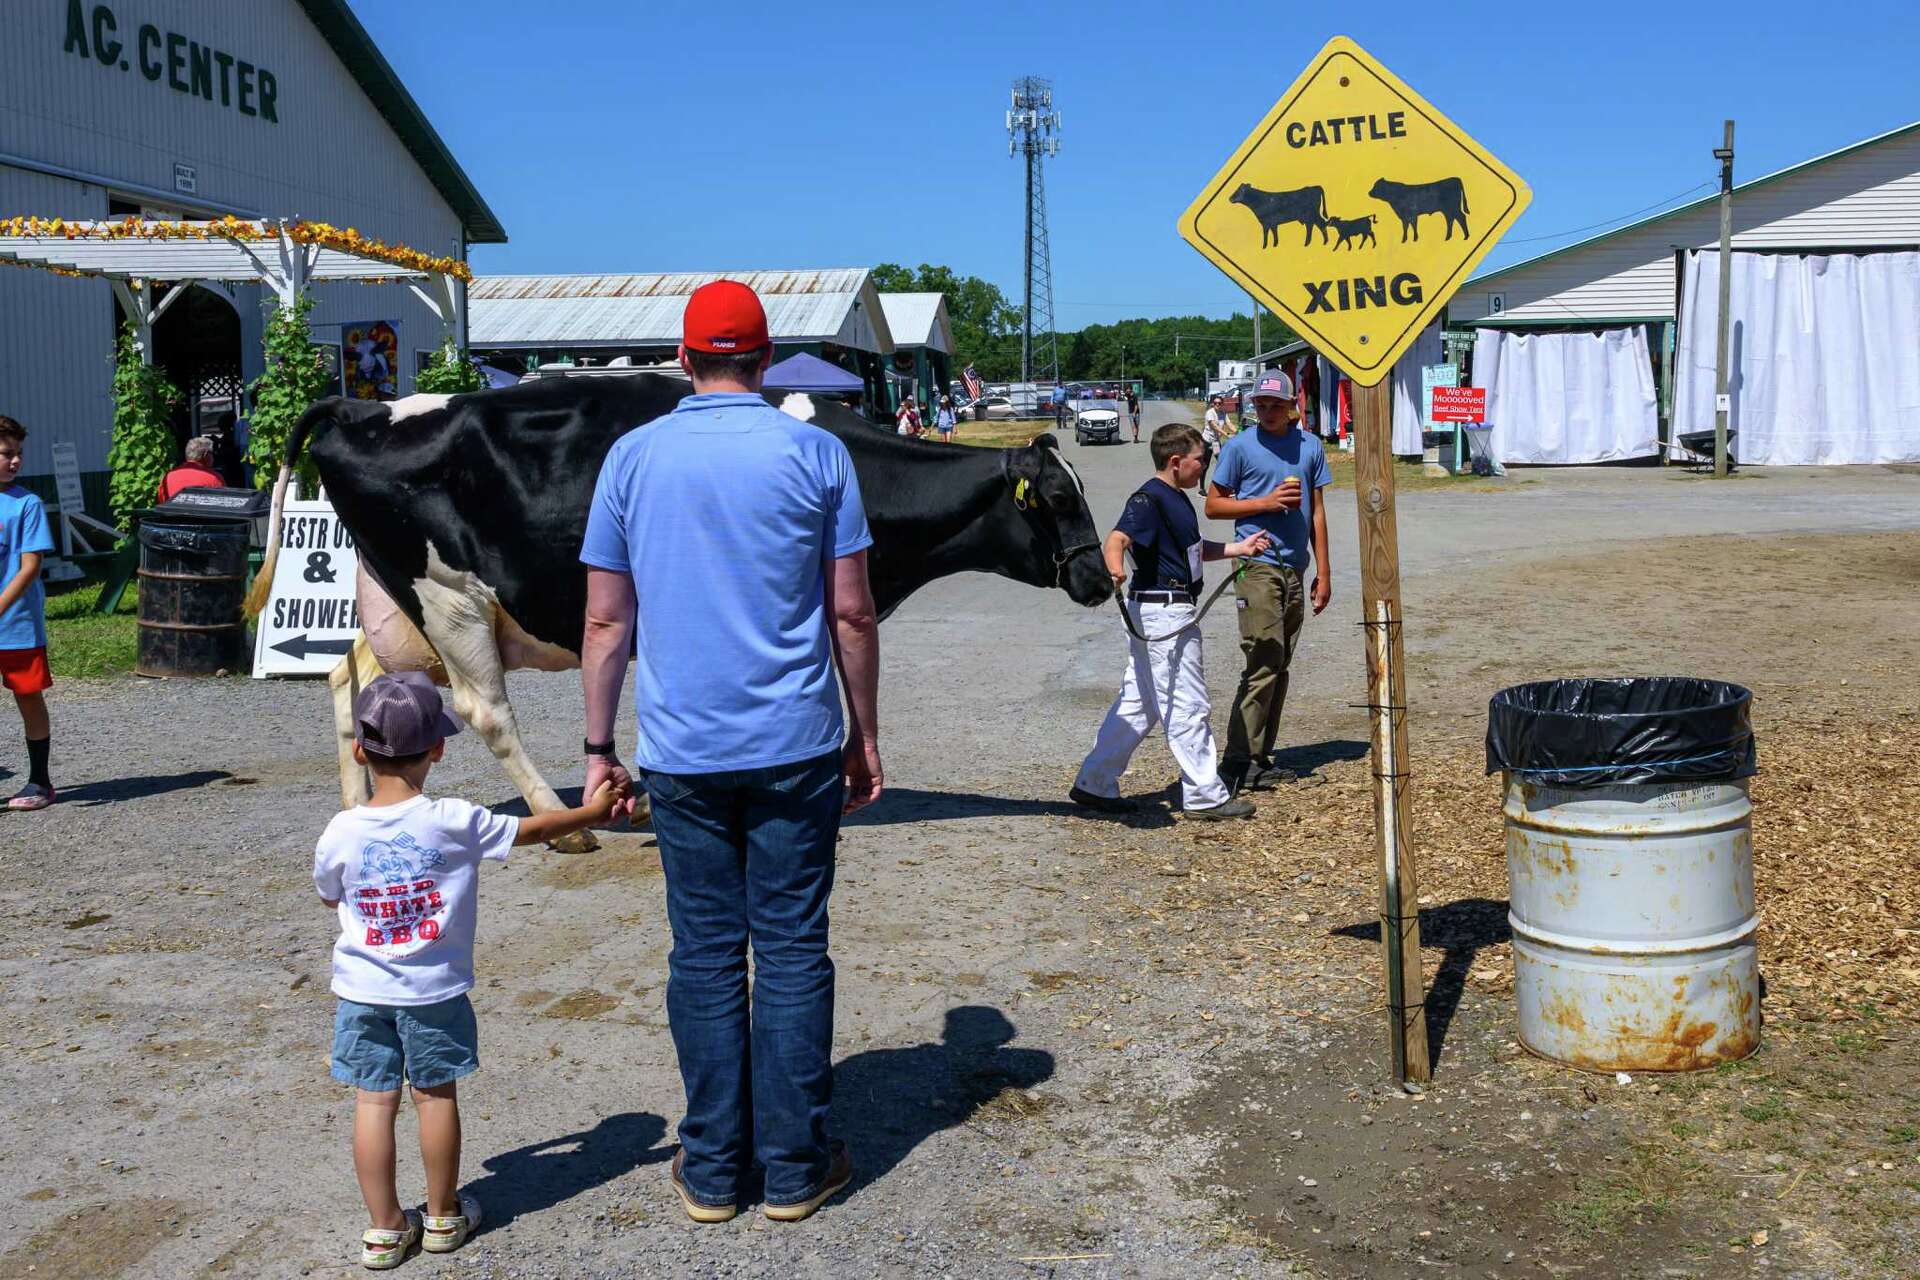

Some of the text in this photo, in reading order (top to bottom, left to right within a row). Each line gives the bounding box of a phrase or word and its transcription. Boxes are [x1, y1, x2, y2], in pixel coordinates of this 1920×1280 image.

[139, 24, 278, 123] CENTER
[1286, 111, 1407, 149] CATTLE
[1302, 272, 1424, 314] XING
[1494, 296, 1501, 313] 9
[303, 551, 337, 583] &
[357, 891, 443, 918] WHITE
